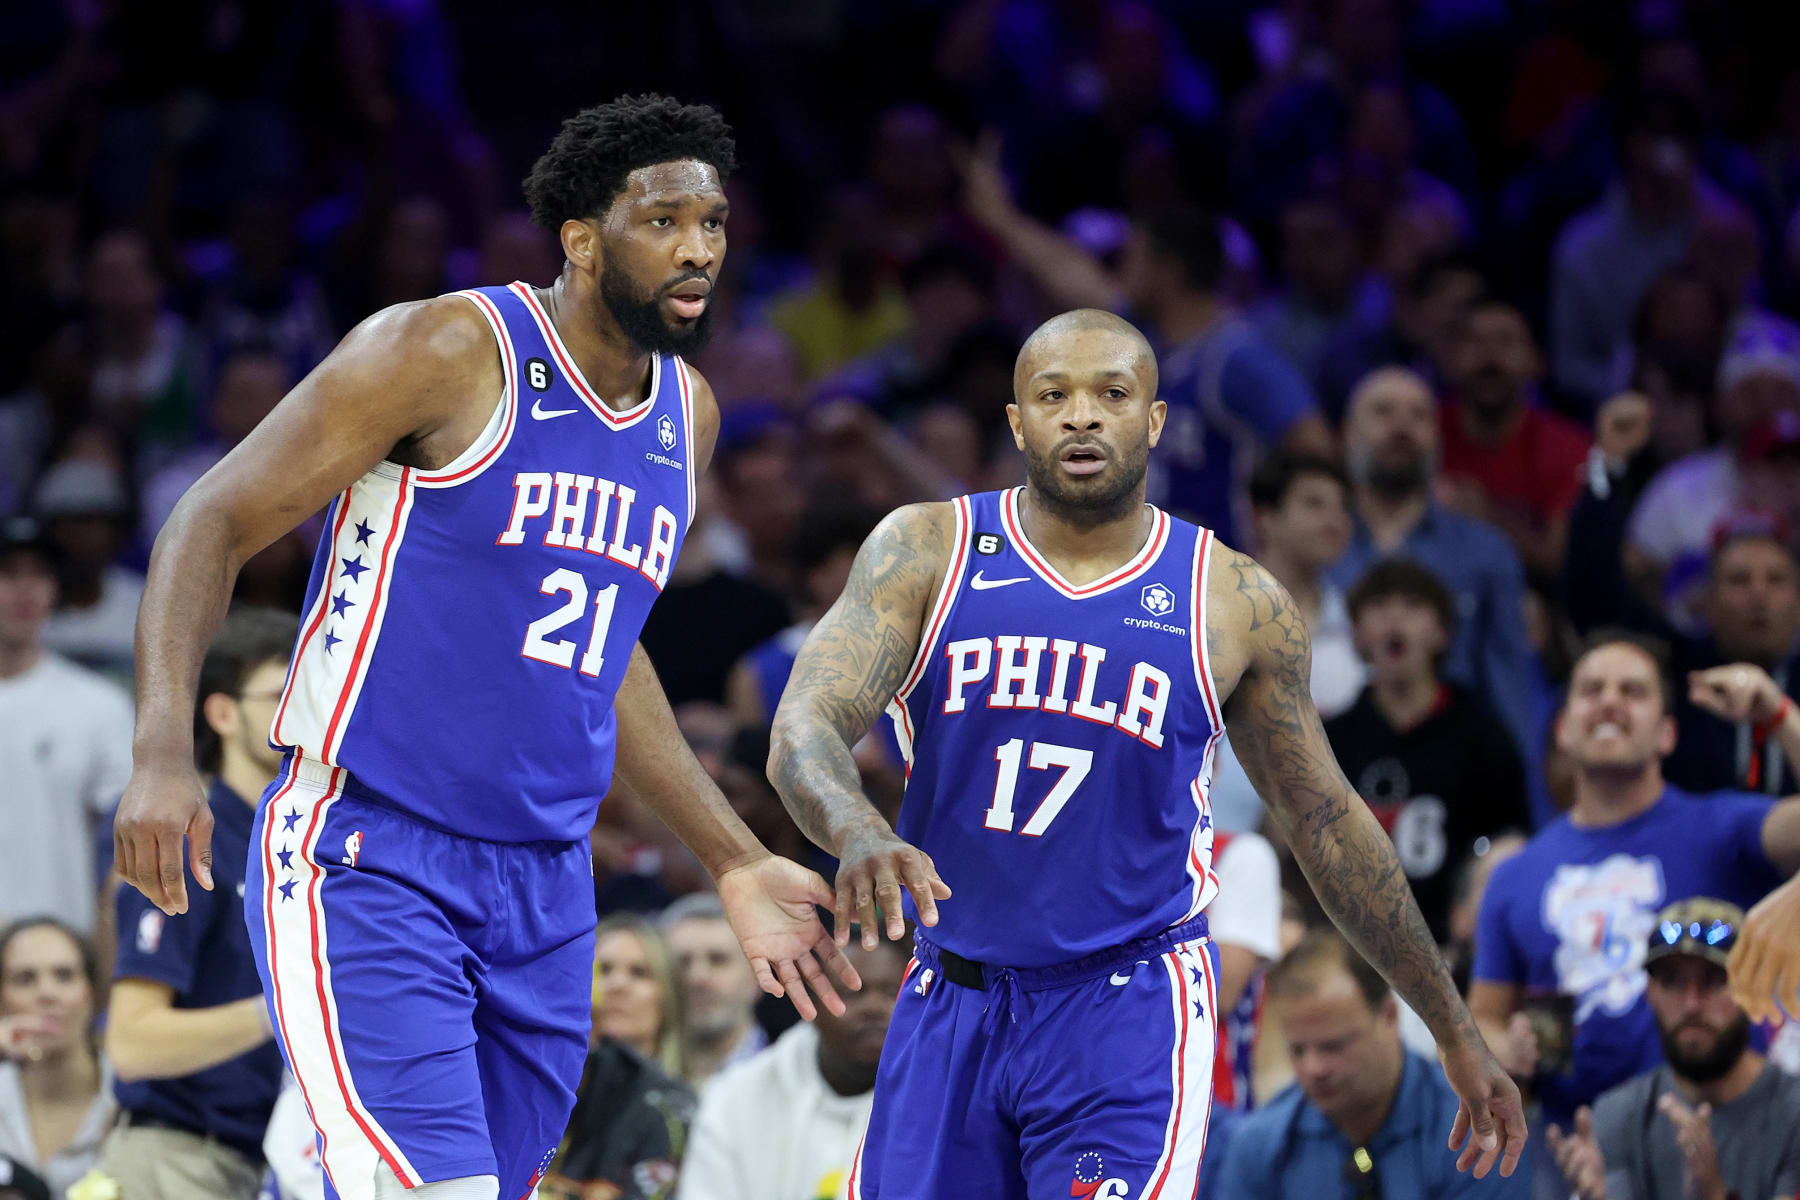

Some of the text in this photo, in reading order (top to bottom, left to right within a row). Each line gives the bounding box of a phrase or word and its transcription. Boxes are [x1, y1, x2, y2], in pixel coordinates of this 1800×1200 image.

[529, 361, 547, 389] 6
[645, 452, 683, 471] crypto.com
[495, 471, 678, 593] PHILA
[977, 535, 999, 554] 6
[521, 567, 620, 678] 21
[1123, 615, 1186, 637] crypto.com
[942, 635, 1172, 750] PHILA
[983, 737, 1094, 837] 17
